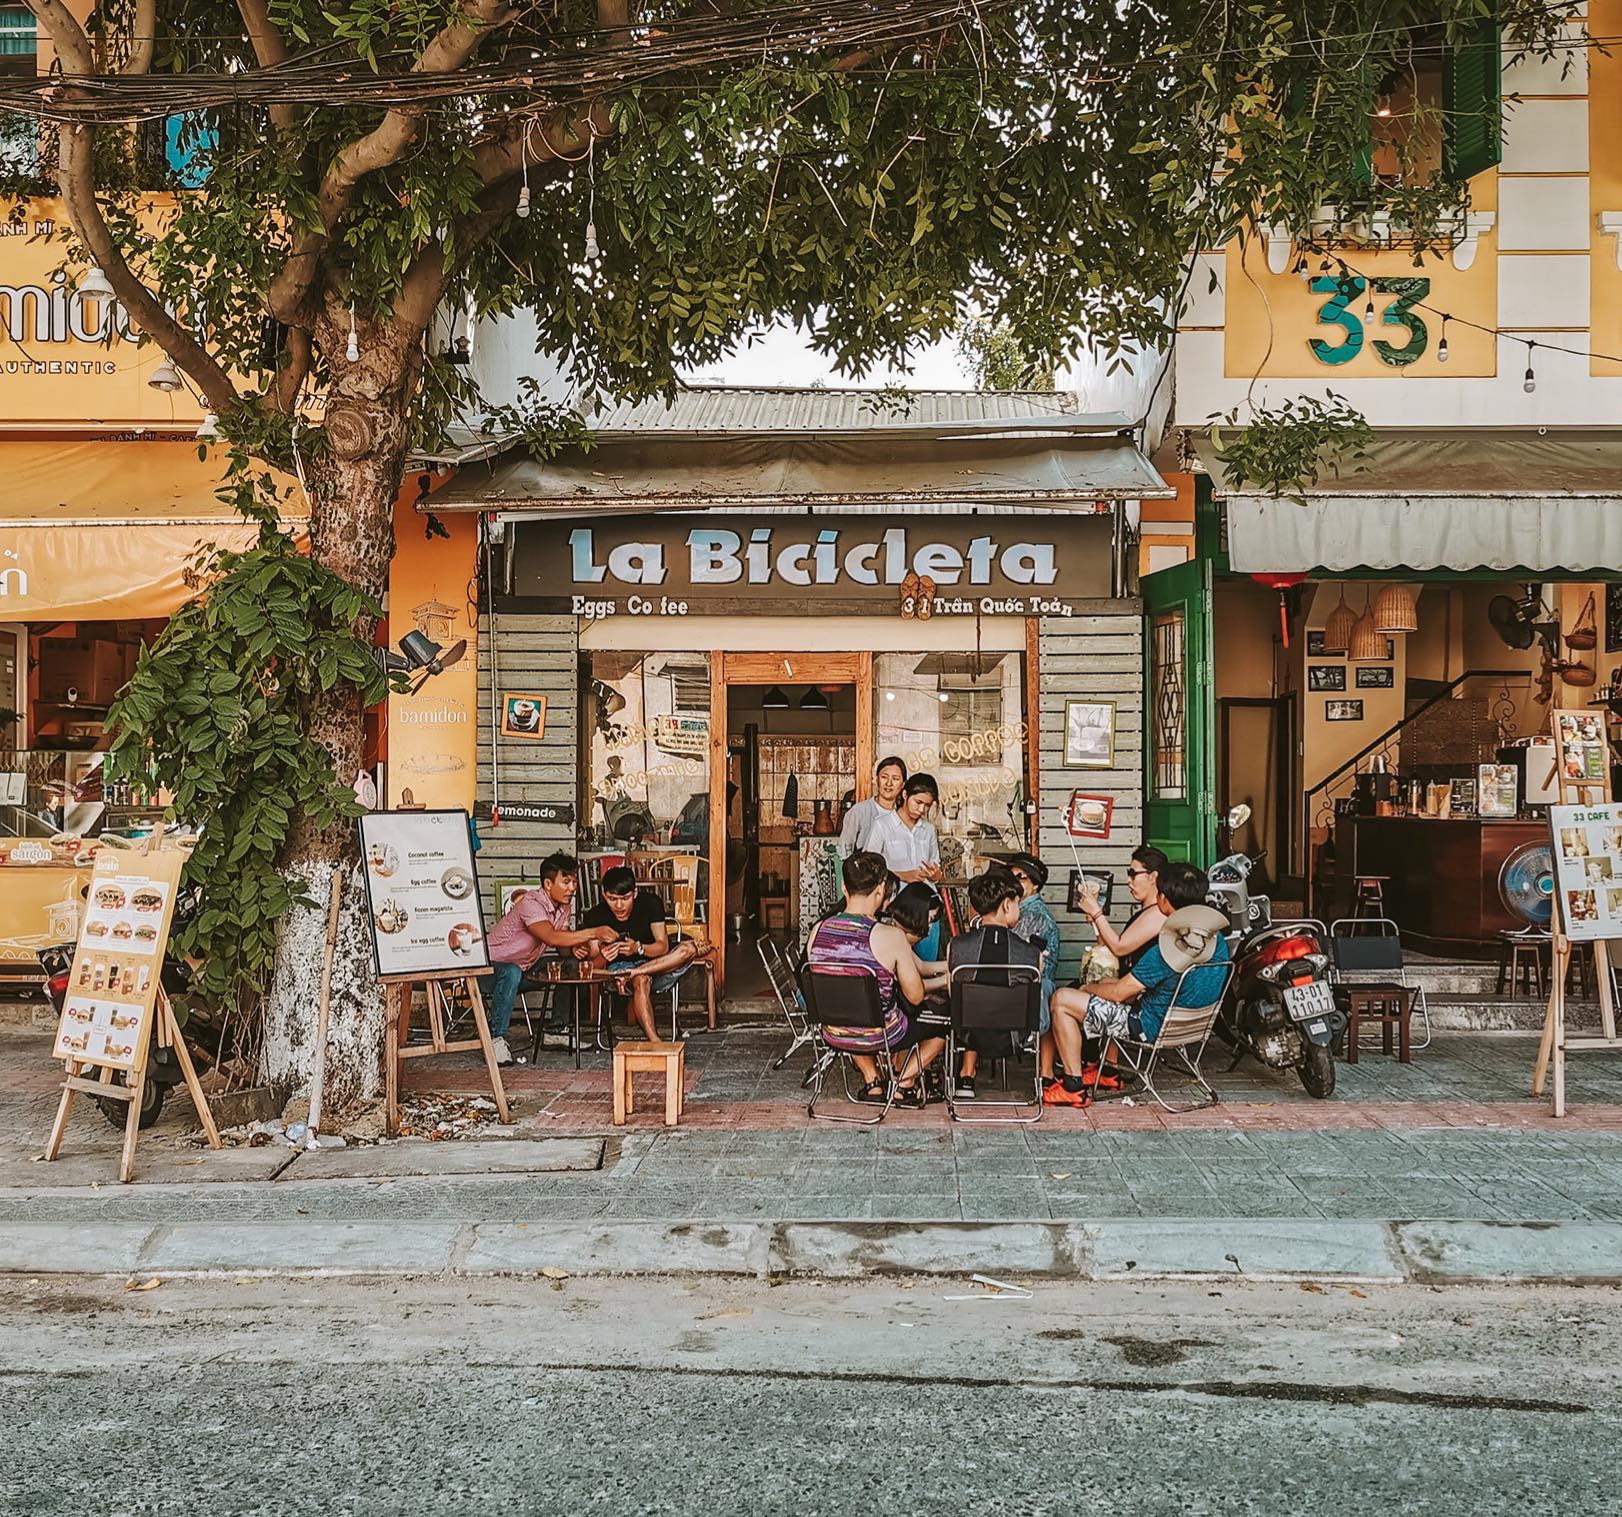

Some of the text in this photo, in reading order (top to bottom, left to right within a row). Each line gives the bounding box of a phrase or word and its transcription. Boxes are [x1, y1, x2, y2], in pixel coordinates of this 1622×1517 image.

[1307, 276, 1430, 367] 33
[568, 528, 1058, 586] La Bicicleta
[571, 595, 616, 619] Eggs
[934, 597, 973, 614] Trần
[980, 597, 1024, 614] Quốc
[400, 706, 467, 724] bamidon
[1573, 811, 1610, 821] 33 CAFE
